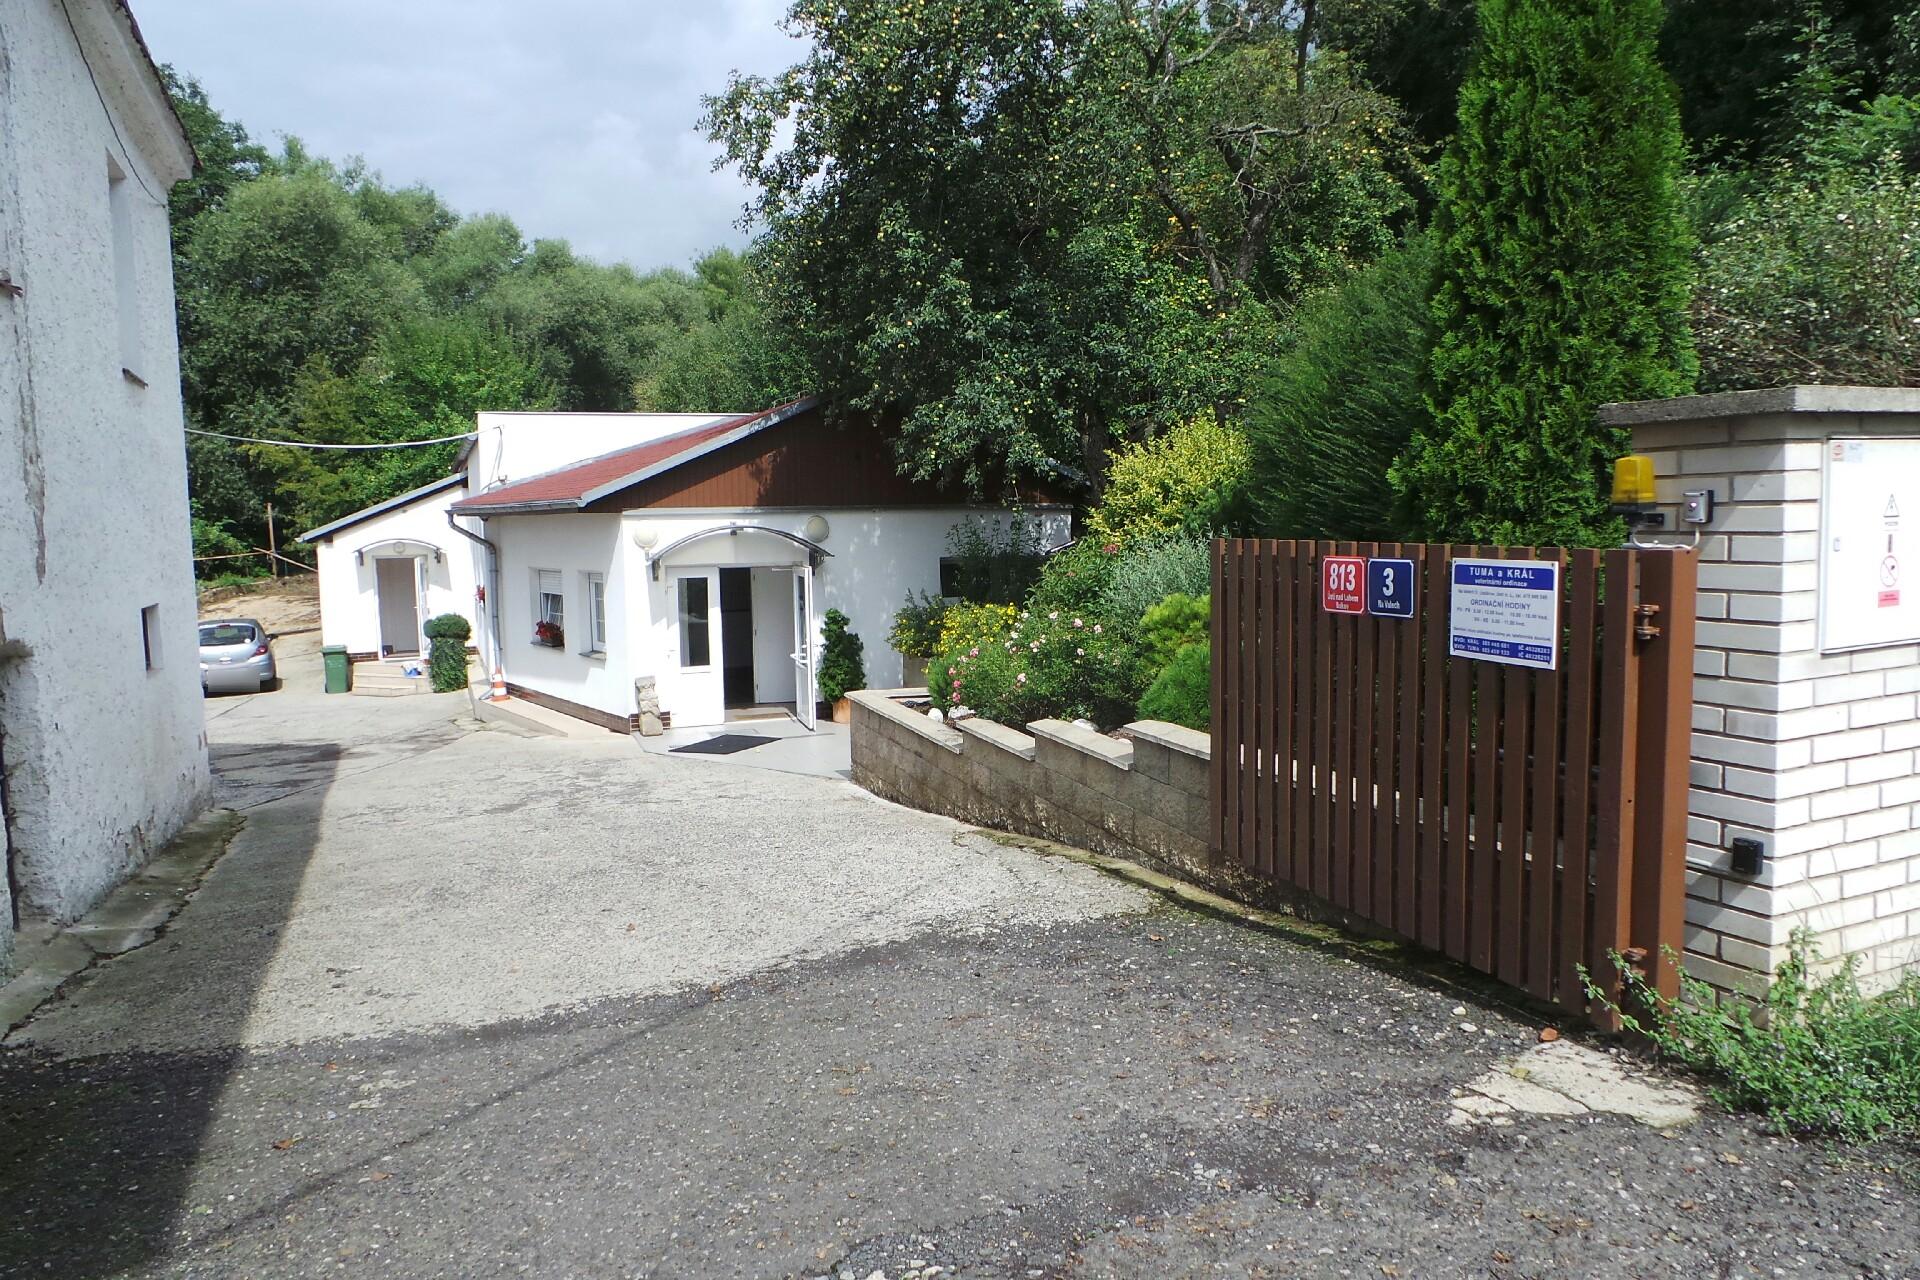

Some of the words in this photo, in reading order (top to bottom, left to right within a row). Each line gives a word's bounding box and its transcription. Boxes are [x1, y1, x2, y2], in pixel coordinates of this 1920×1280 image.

[1330, 564, 1356, 591] 813
[1508, 568, 1535, 579] KRÁL
[1383, 568, 1394, 597] 3
[1345, 594, 1359, 602] Labem
[1471, 600, 1504, 609] ORDINAČNÍ
